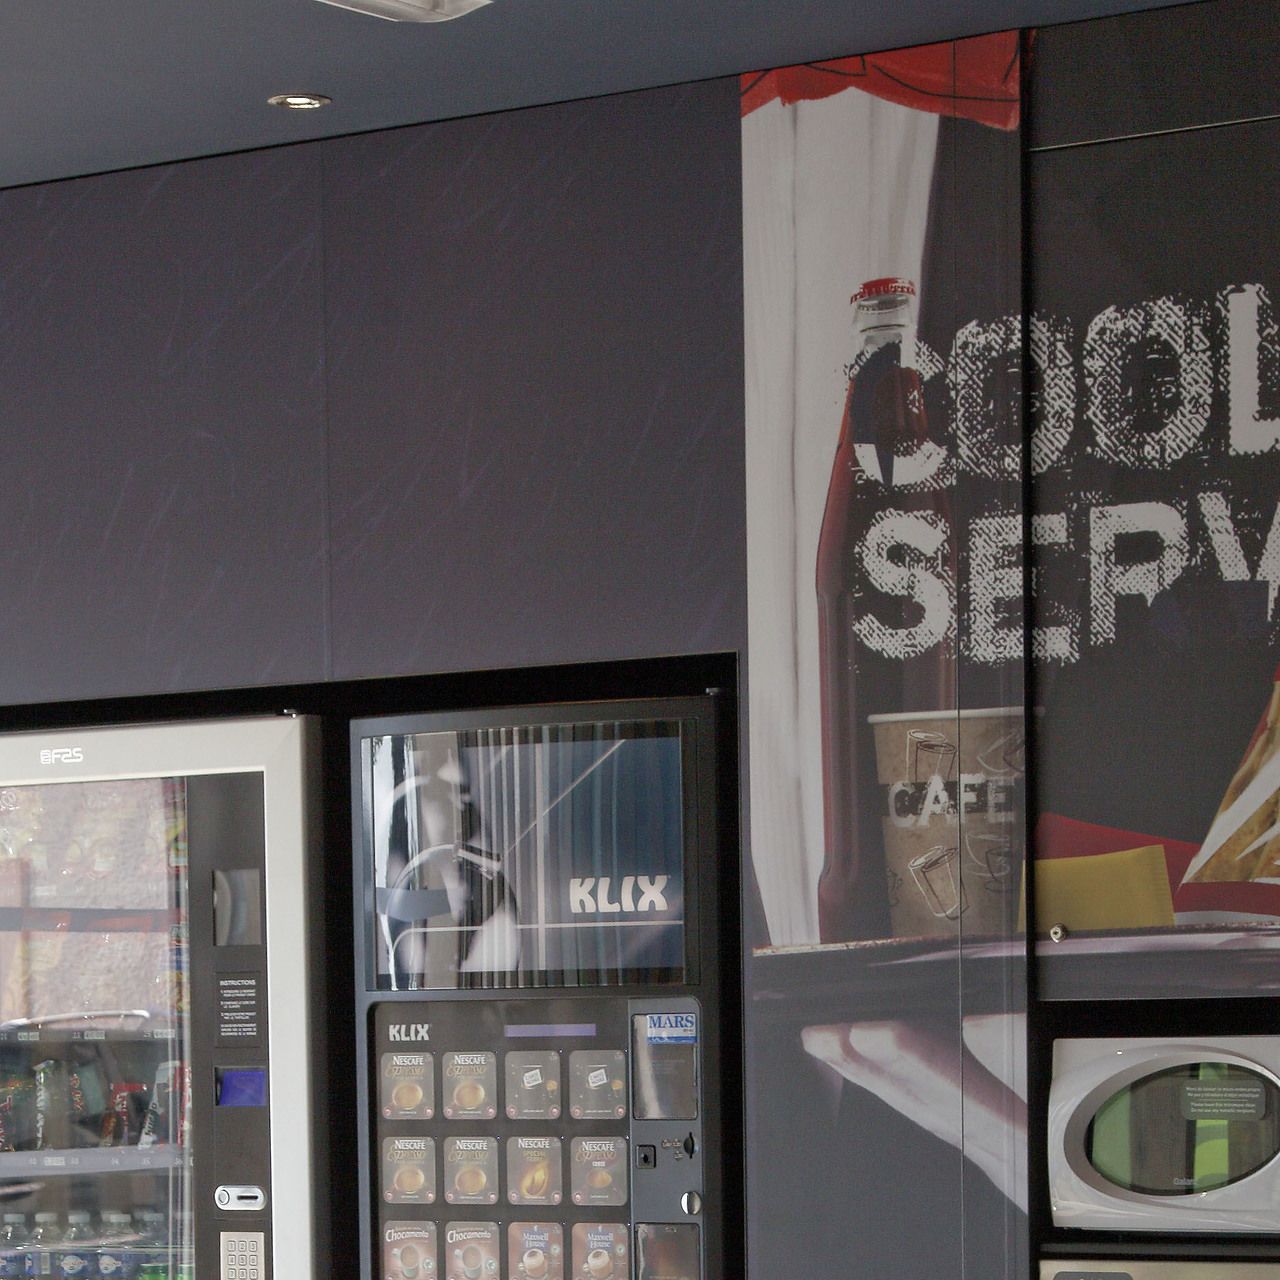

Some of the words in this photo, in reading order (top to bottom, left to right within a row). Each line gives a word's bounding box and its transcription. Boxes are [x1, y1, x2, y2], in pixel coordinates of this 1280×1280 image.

[569, 875, 669, 913] KLIX
[648, 1014, 695, 1030] MARS
[388, 1023, 430, 1042] KLIX
